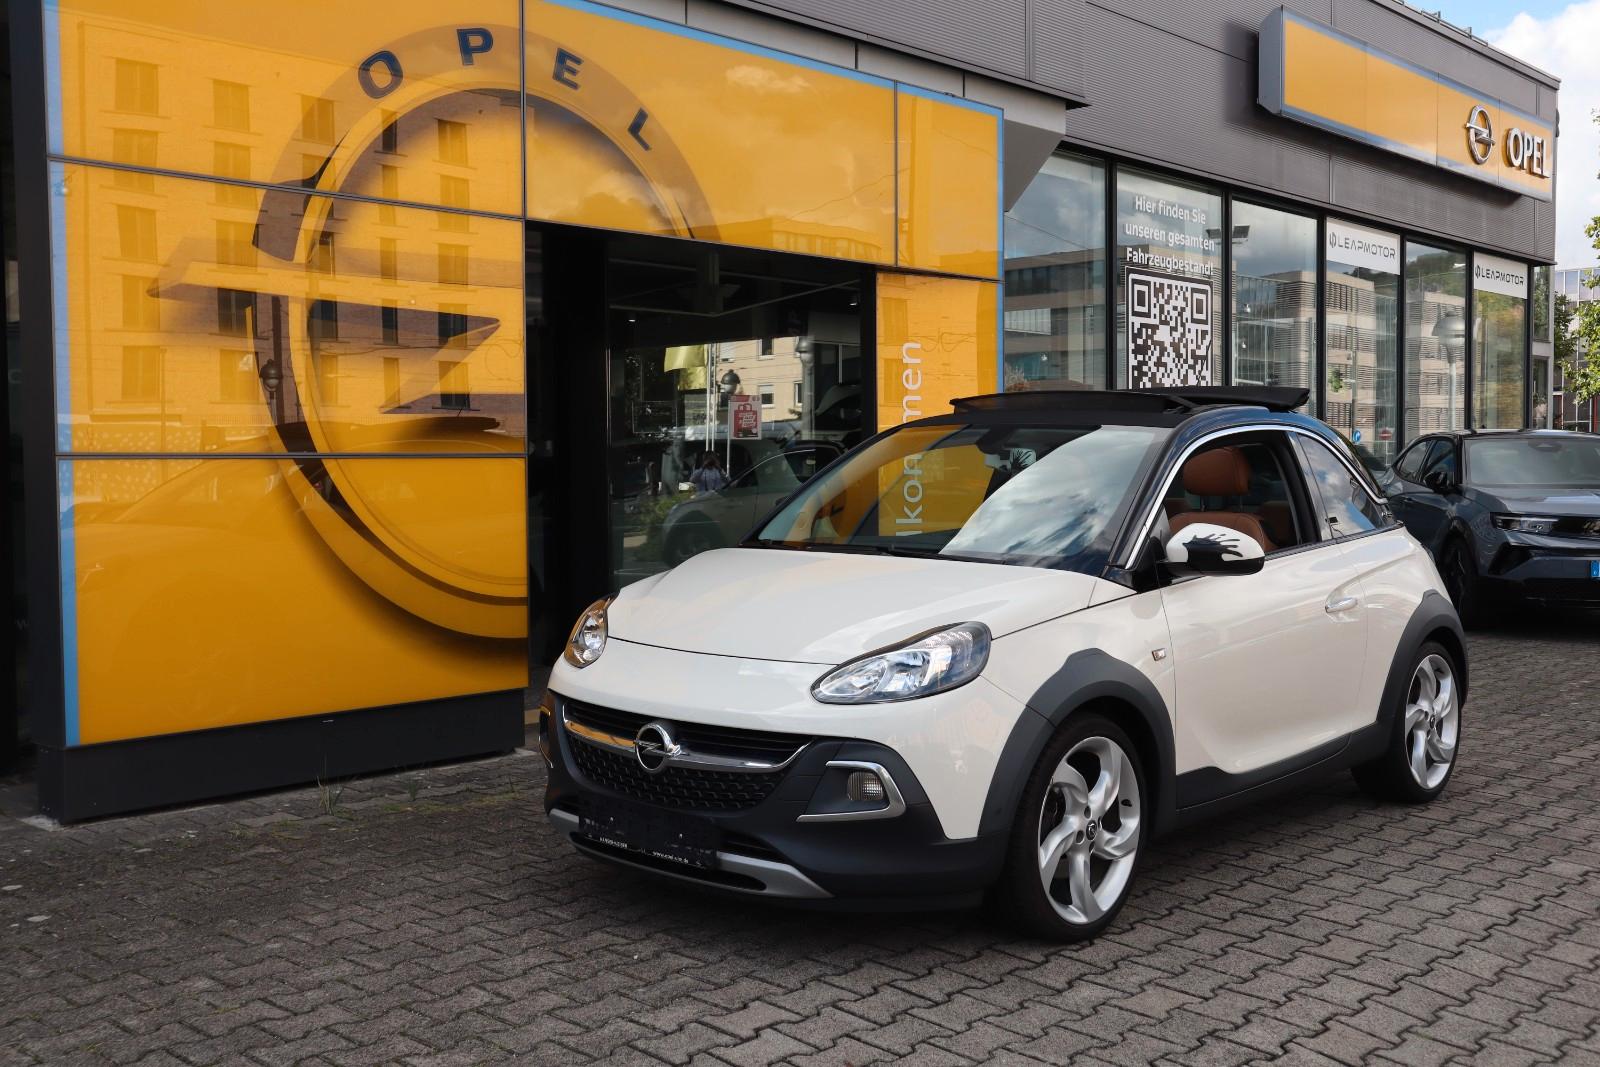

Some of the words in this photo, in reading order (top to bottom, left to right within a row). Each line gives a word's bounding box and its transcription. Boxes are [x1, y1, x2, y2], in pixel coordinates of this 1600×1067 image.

[357, 27, 652, 151] OPEL
[1507, 127, 1551, 179] OPEL
[1135, 195, 1157, 214] Hier
[1158, 199, 1190, 220] finden
[1192, 208, 1206, 225] Sie
[1125, 223, 1166, 242] unseren
[1168, 231, 1215, 251] gesamten
[1337, 233, 1396, 260] LEAPMOTOR
[1126, 247, 1214, 276] Fahrzeugbestand!
[1481, 267, 1524, 286] LEAPMOTOR
